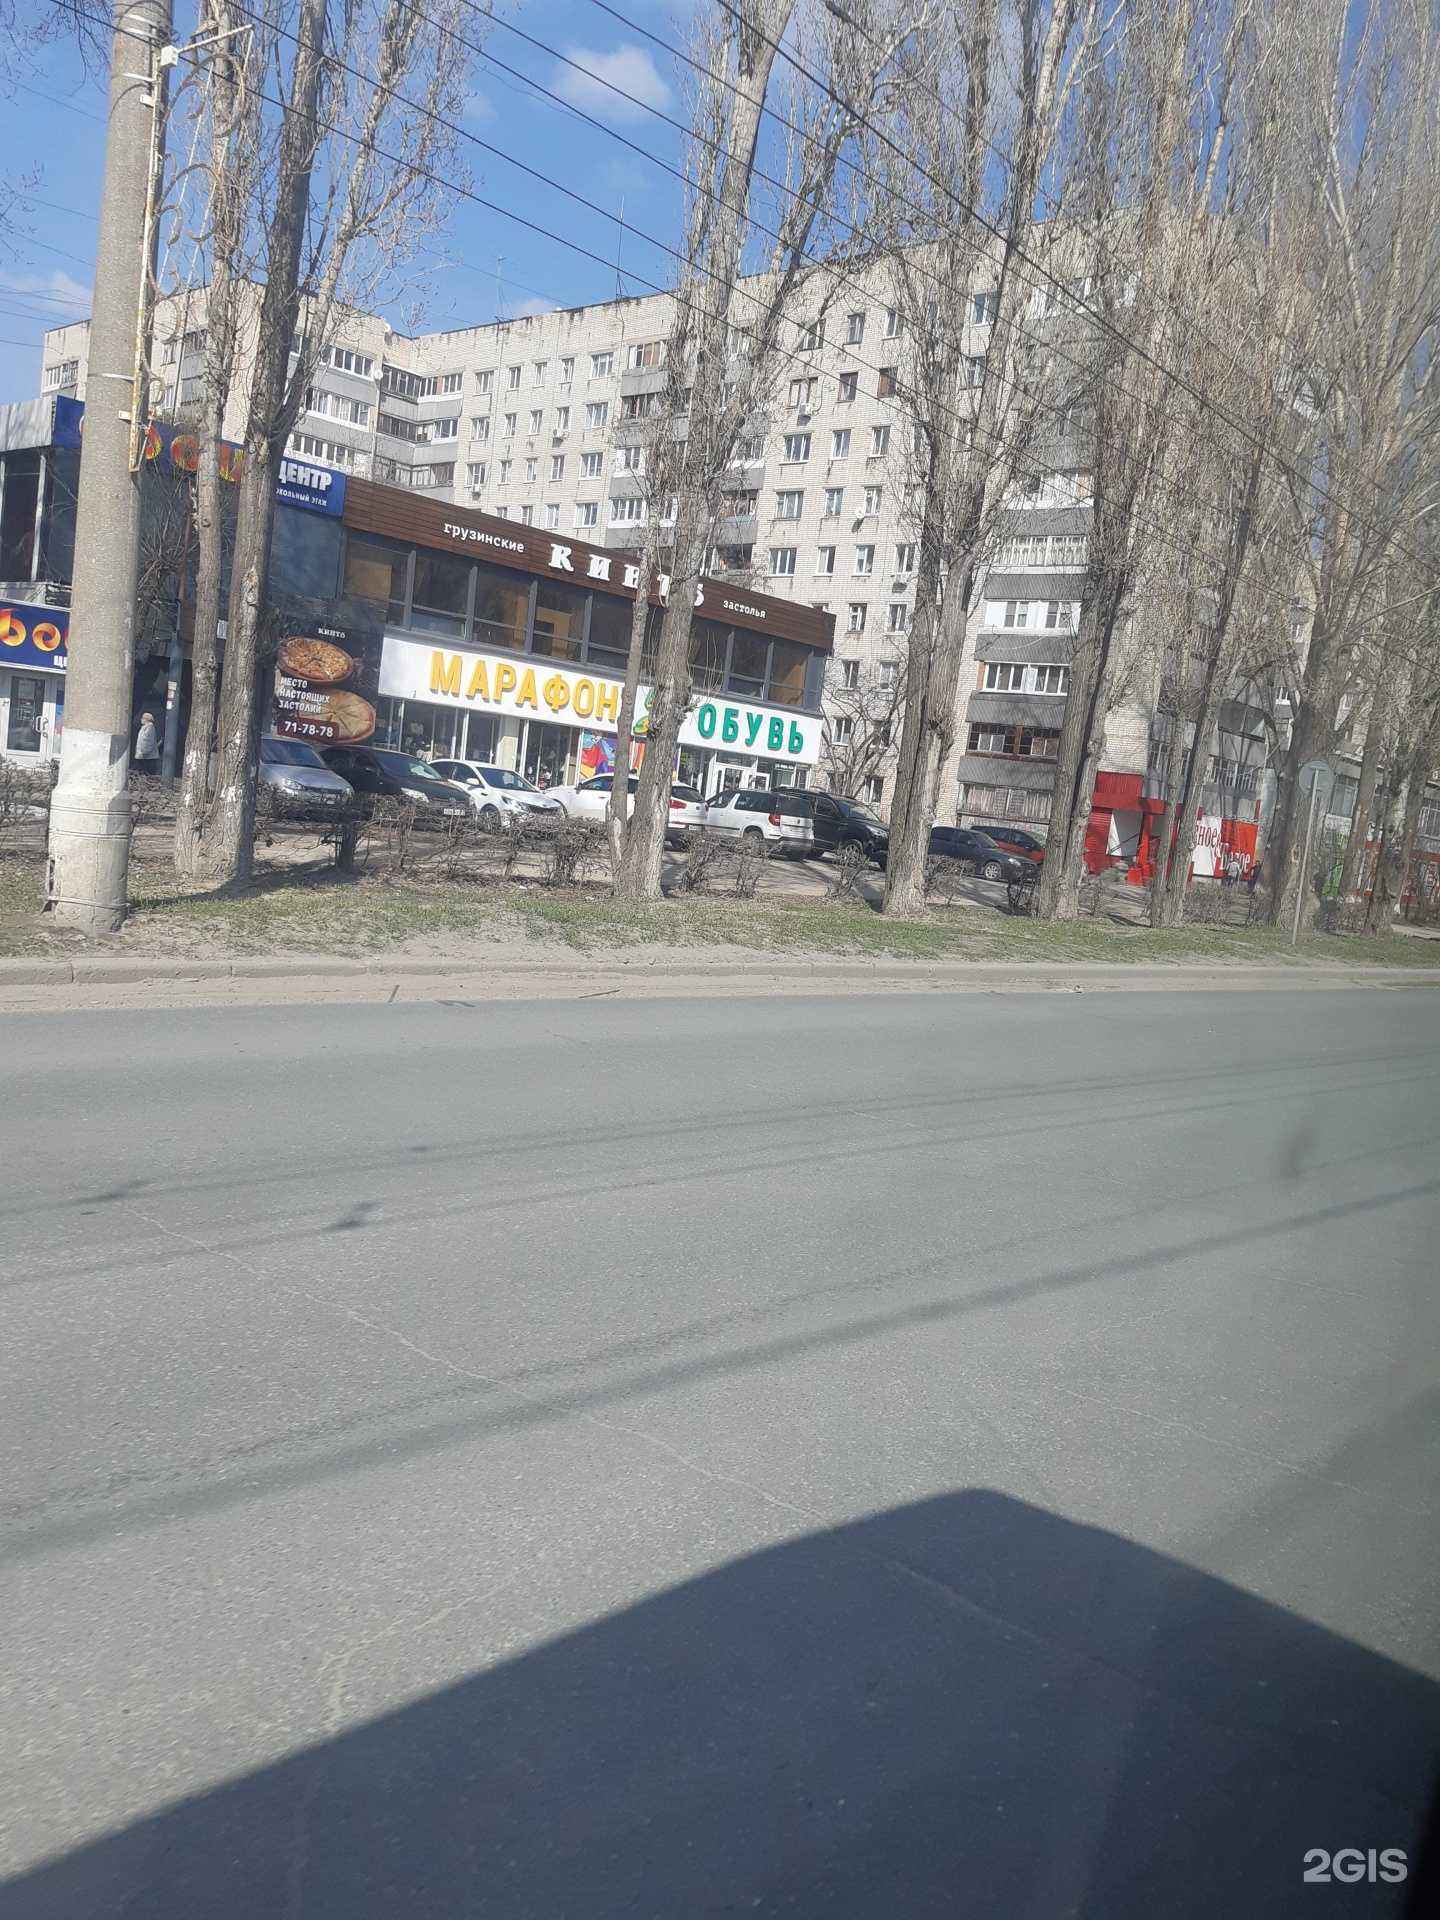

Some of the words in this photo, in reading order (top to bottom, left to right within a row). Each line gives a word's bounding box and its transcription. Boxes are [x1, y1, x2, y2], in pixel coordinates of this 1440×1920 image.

[278, 460, 332, 491] ЦЕНТР
[443, 521, 525, 553] грузинские
[723, 599, 767, 620] застолья
[280, 676, 308, 689] МЕСТО
[280, 687, 331, 704] НАСТОЯЩИХ
[429, 650, 619, 723] МАРАФОН
[284, 720, 334, 737] 71-78-78
[697, 703, 805, 754] ОБУВЬ
